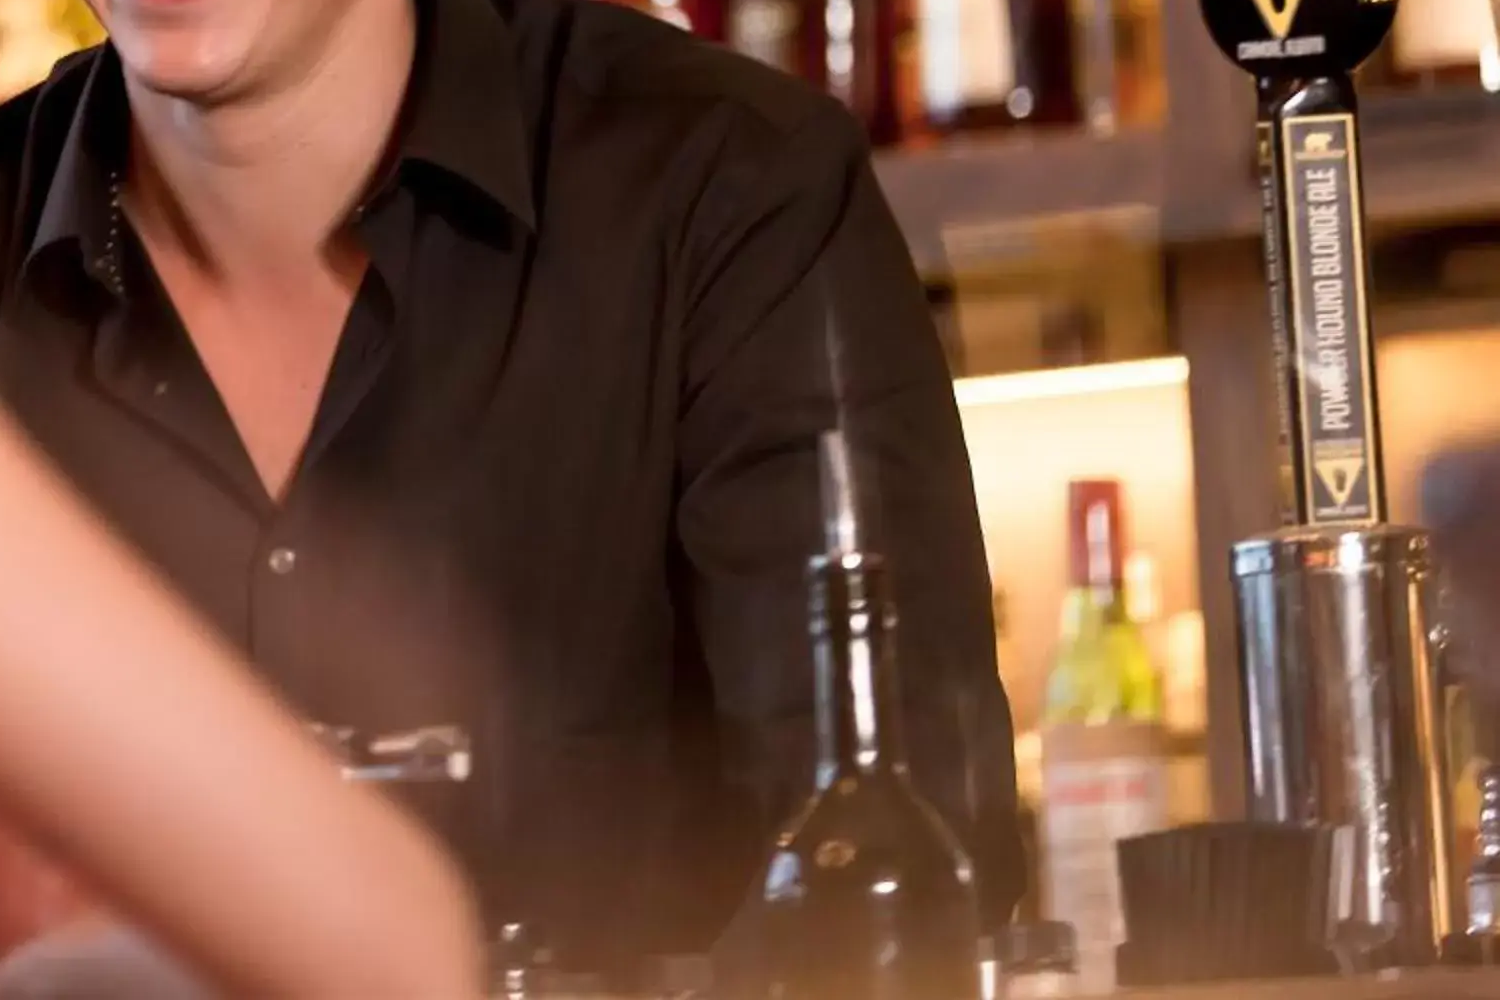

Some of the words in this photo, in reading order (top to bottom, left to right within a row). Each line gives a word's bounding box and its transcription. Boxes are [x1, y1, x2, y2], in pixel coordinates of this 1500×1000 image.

[1305, 168, 1338, 202] ALE
[1308, 204, 1342, 277] BLONDE
[1313, 279, 1346, 347] HOUND
